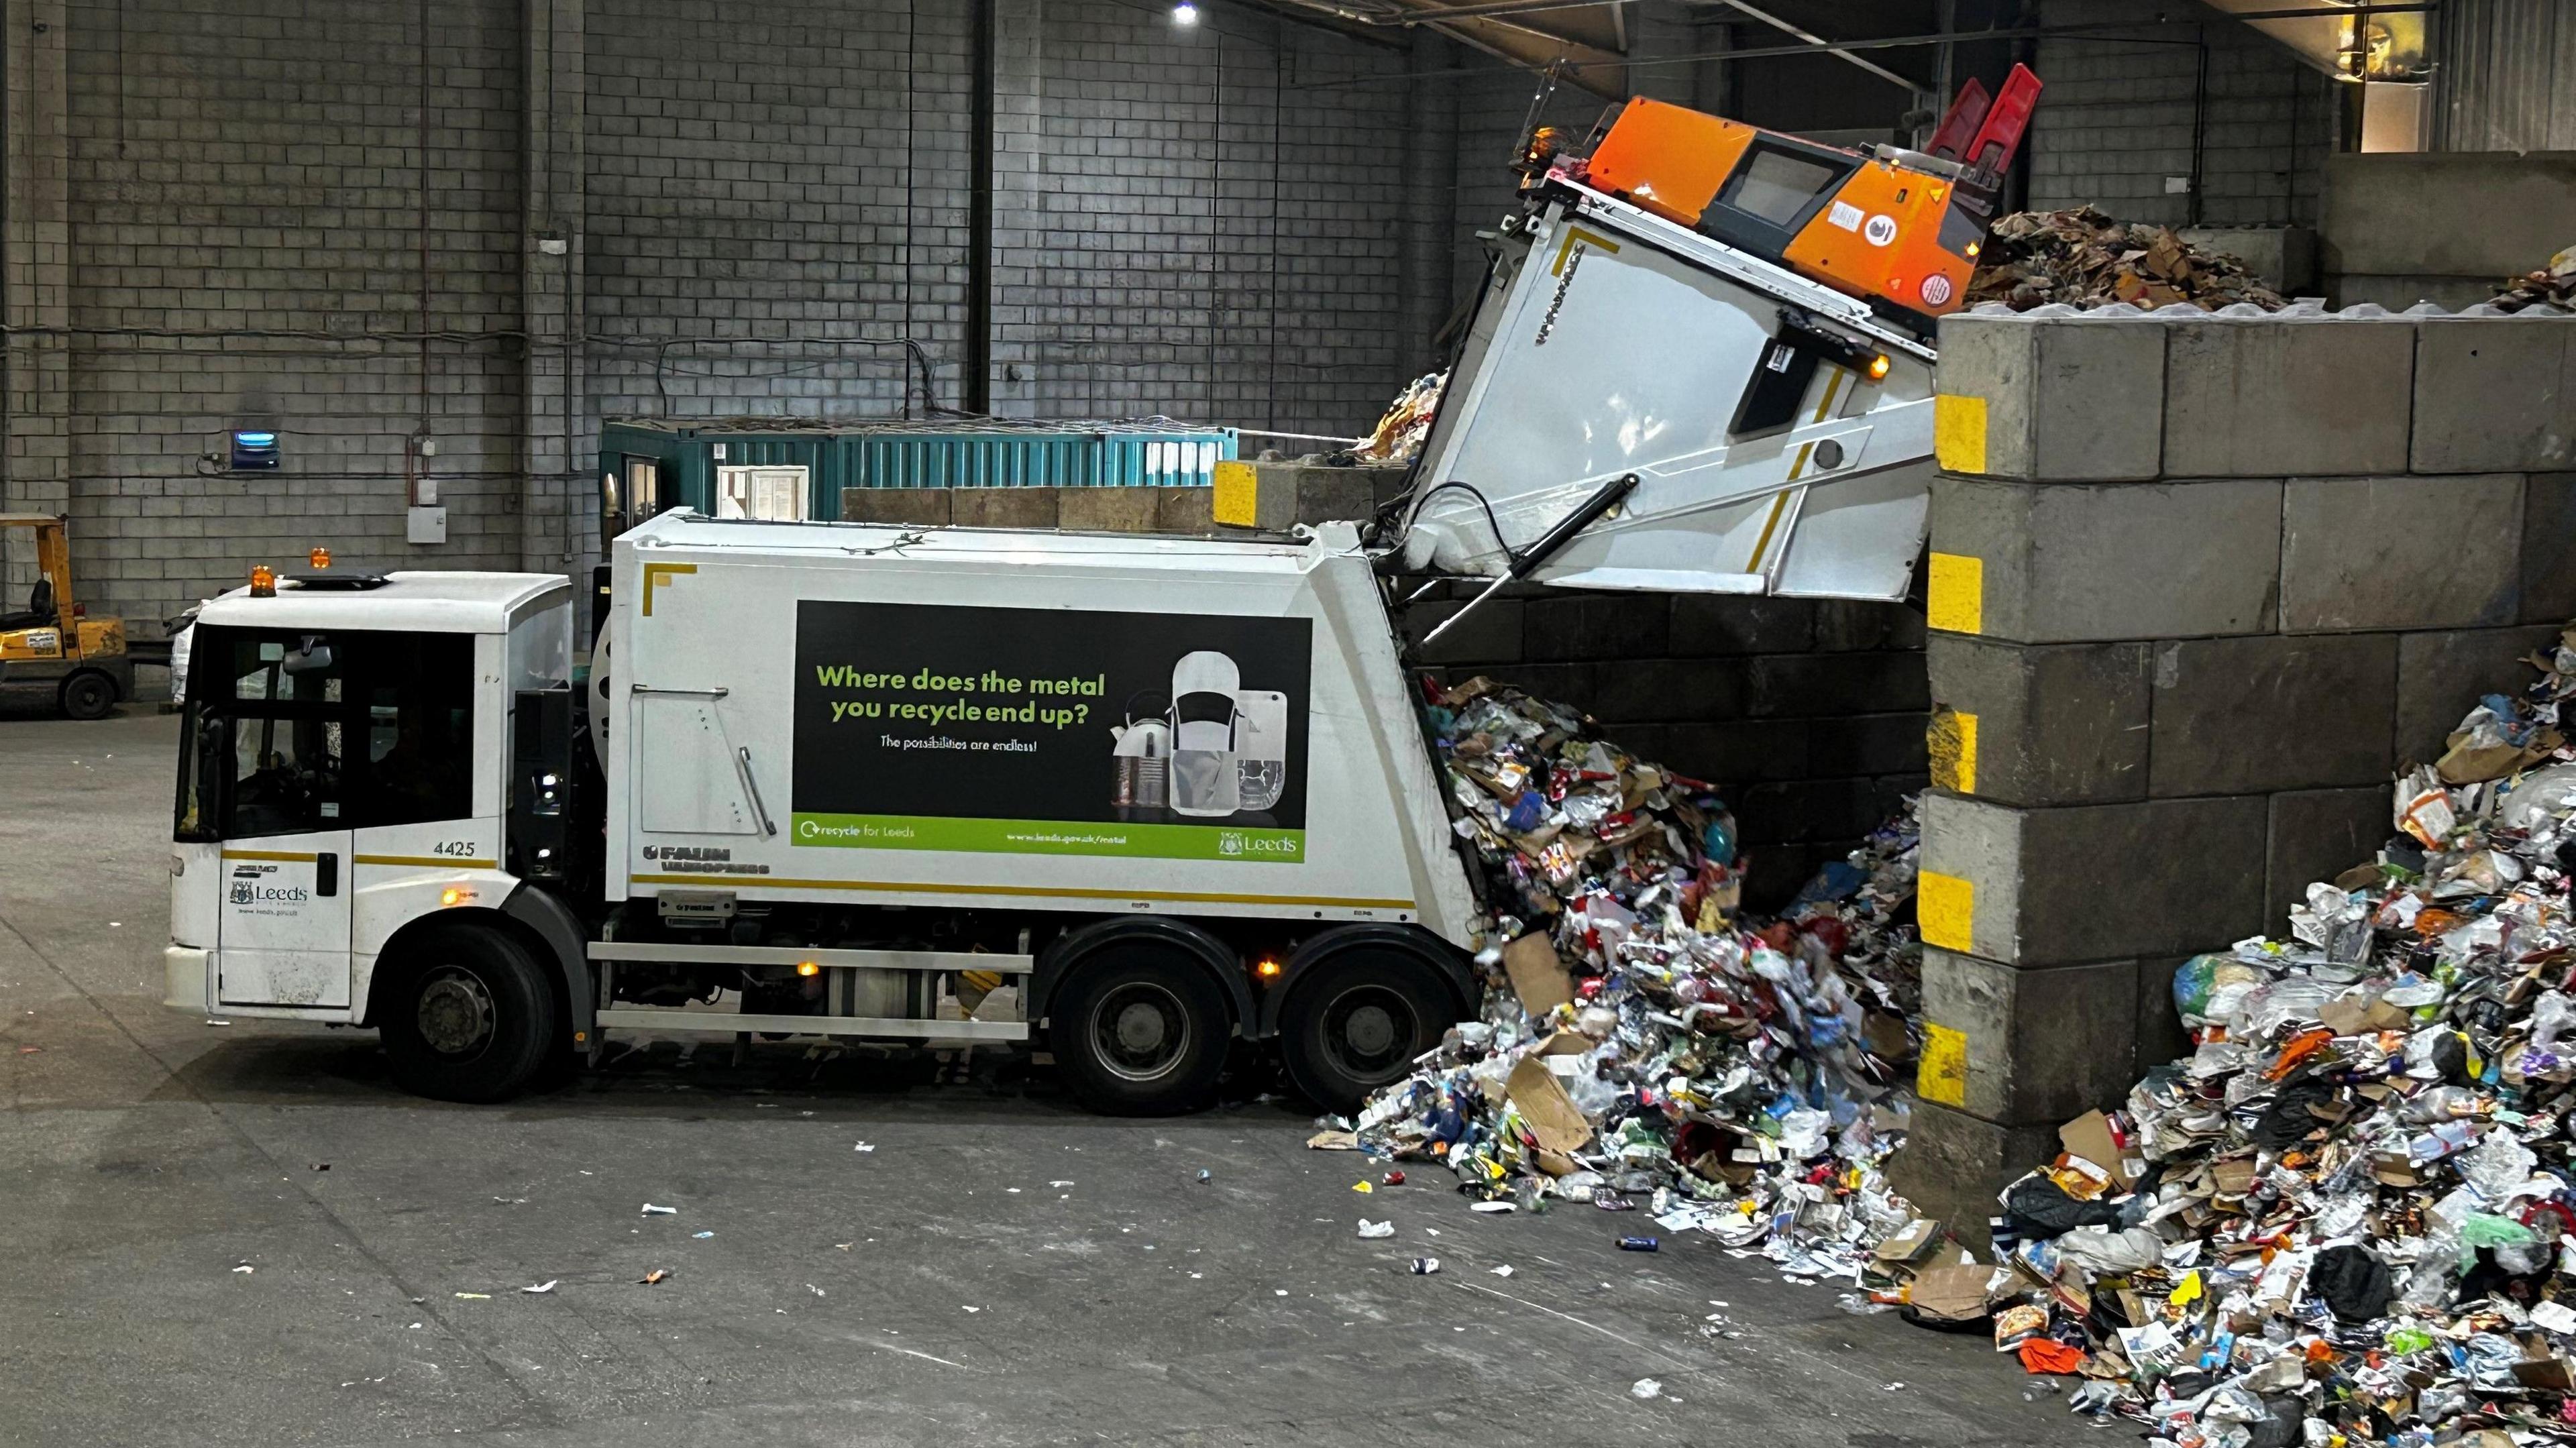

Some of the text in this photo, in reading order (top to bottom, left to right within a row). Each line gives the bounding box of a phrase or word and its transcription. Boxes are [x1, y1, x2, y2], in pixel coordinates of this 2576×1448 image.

[816, 665, 1105, 696] Where does the metal
[830, 698, 1089, 730] you recycle end up?
[880, 734, 1037, 752] The possibilities are endless!
[820, 824, 861, 838] recycle
[863, 824, 879, 836] for
[433, 841, 475, 856] 4425
[1244, 836, 1297, 852] Leeds
[256, 886, 308, 901] Leeds
